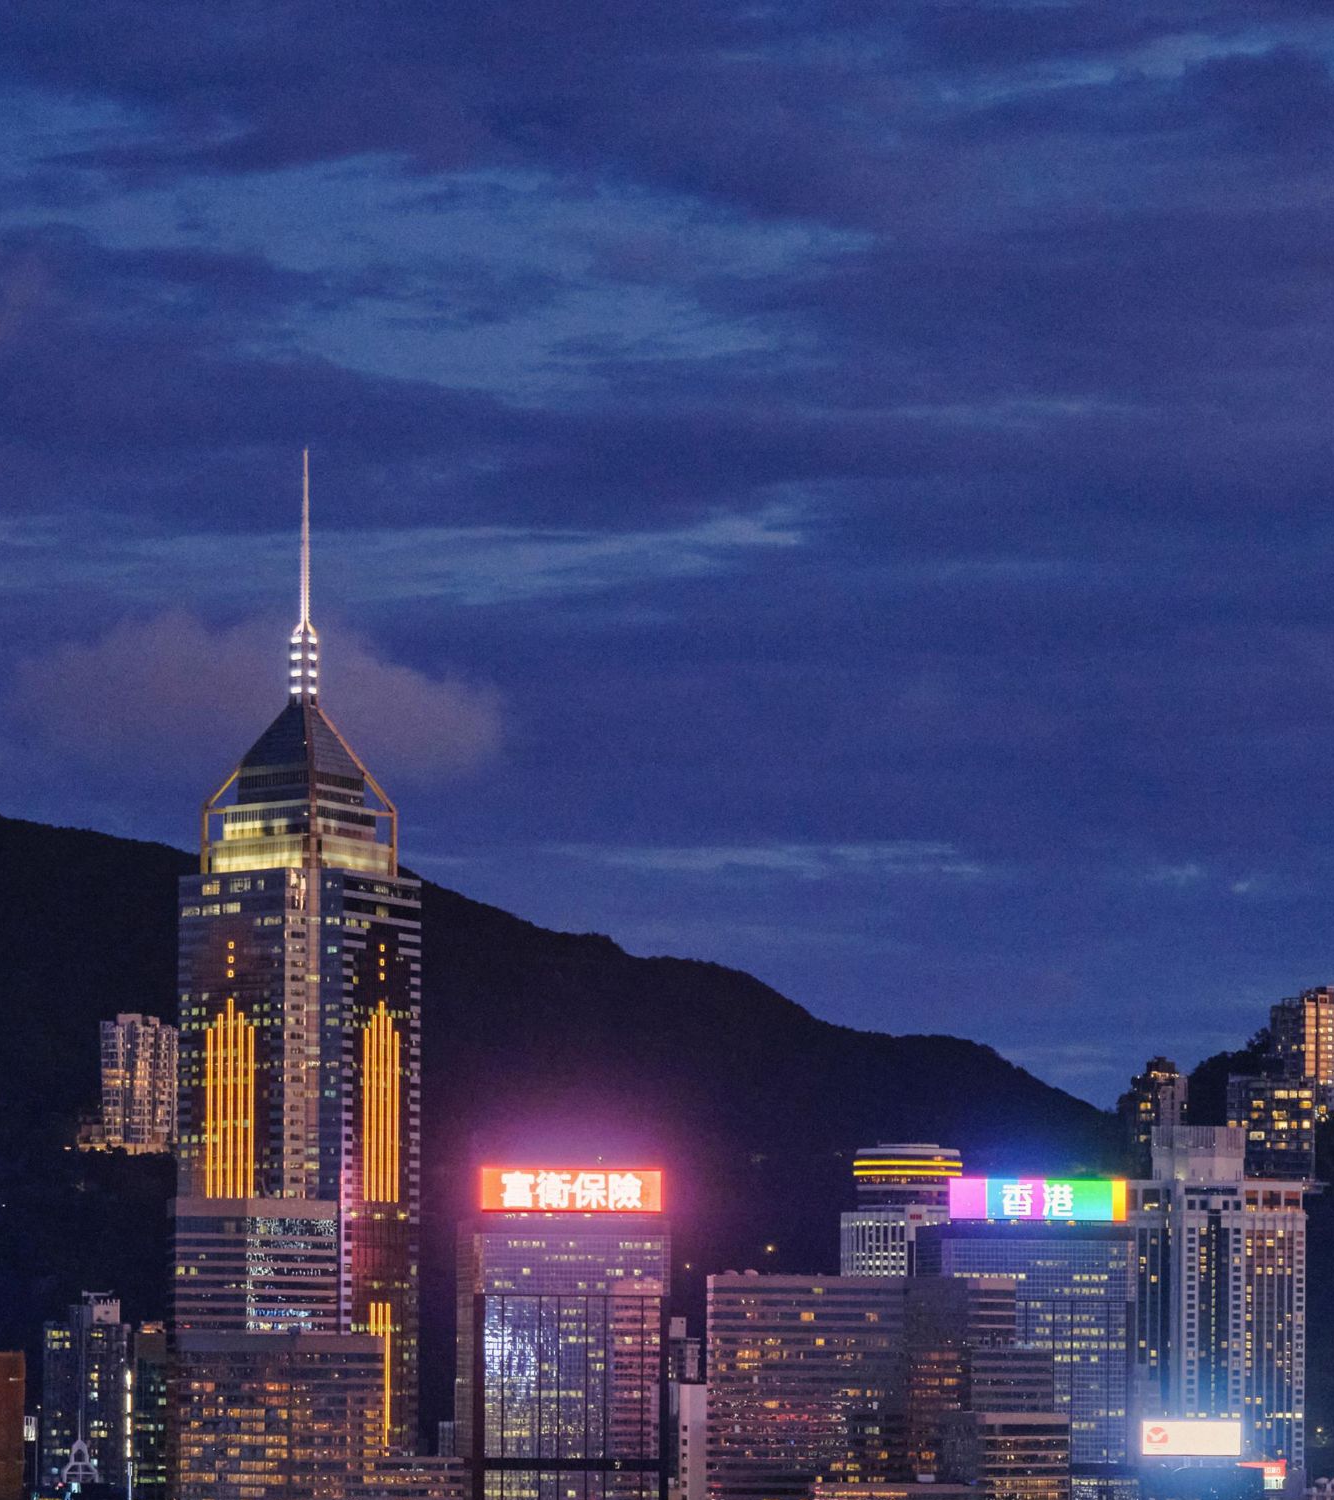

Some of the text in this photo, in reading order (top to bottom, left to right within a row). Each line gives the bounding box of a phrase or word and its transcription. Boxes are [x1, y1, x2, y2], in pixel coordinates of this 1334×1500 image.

[500, 1171, 643, 1211] 富衛保險
[1002, 1183, 1074, 1217] 香港
